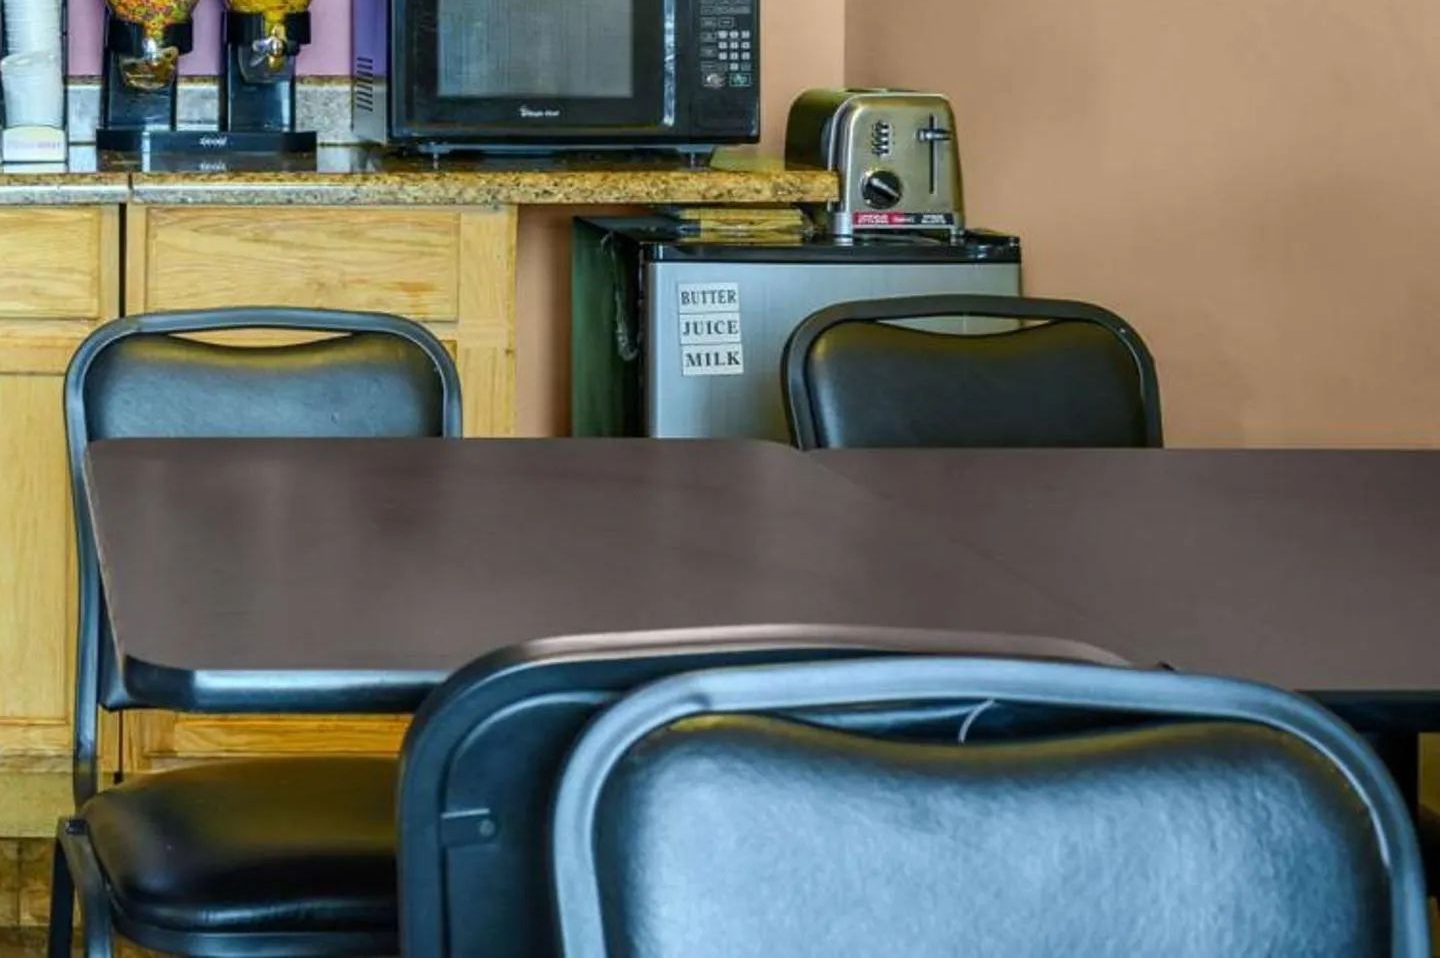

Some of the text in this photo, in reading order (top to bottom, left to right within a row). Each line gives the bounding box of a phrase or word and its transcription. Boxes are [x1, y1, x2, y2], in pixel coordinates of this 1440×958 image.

[681, 289, 737, 305] BUTTER
[683, 320, 739, 336] JUICE
[686, 351, 740, 367] MILK
